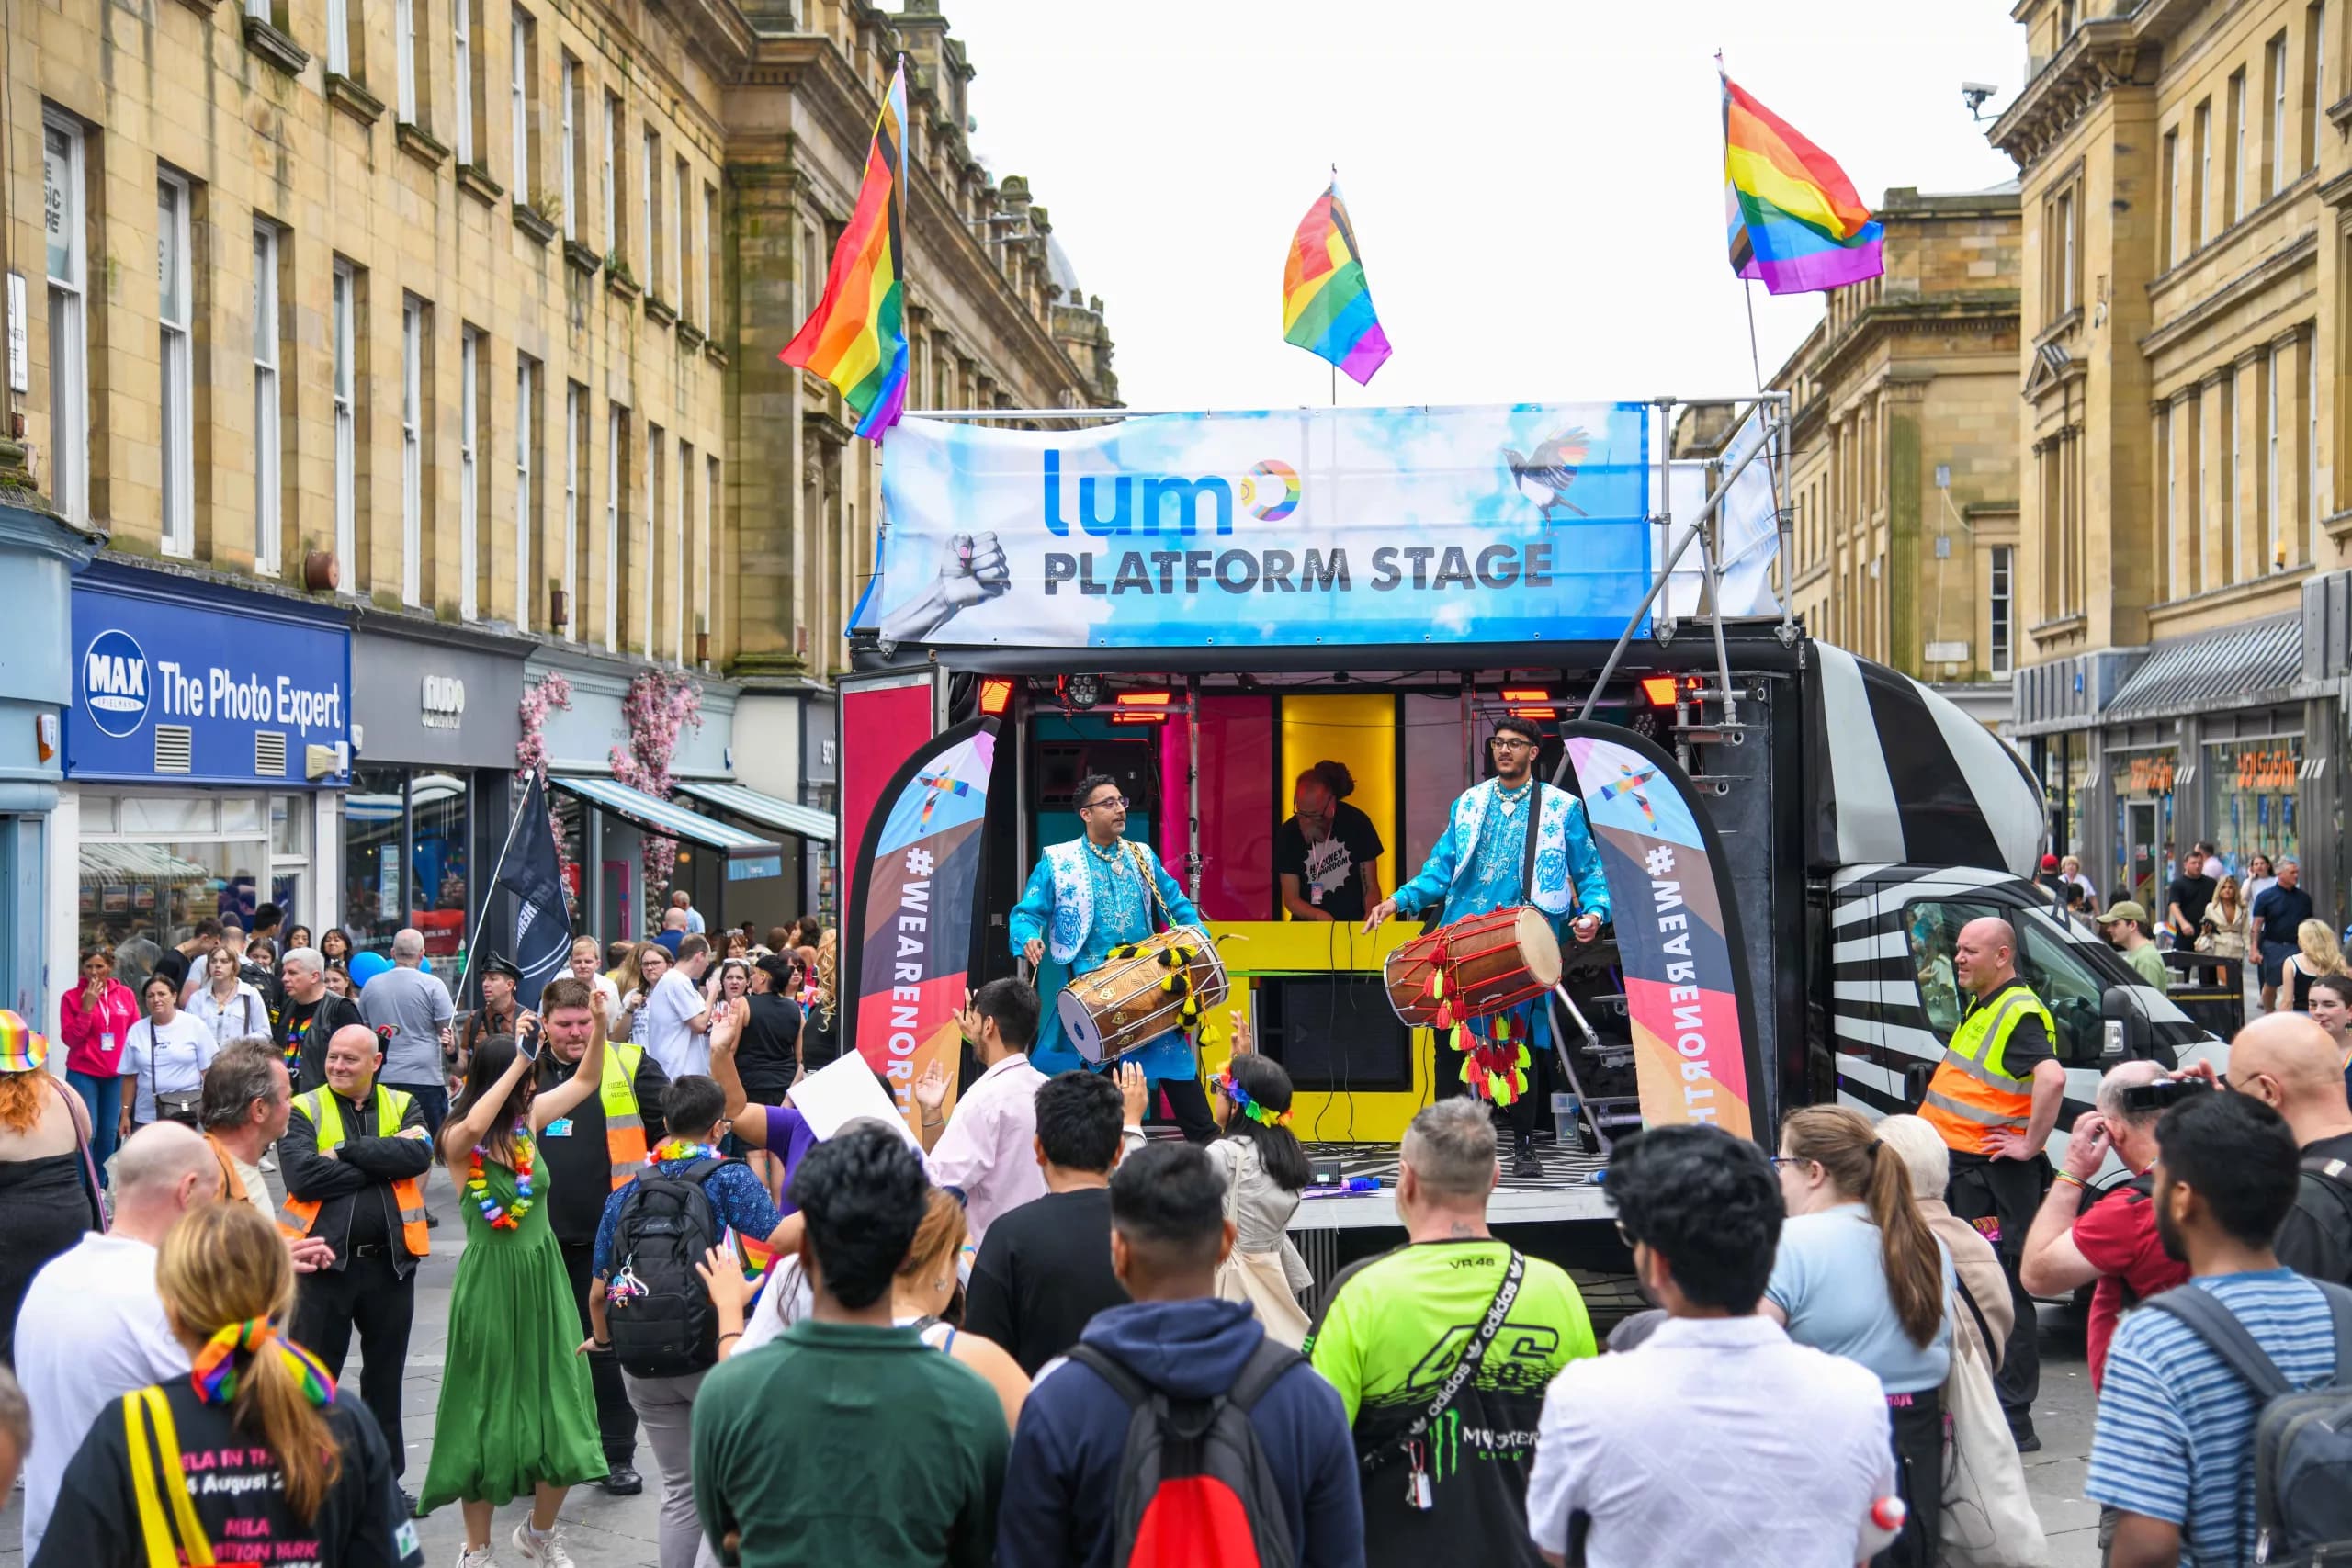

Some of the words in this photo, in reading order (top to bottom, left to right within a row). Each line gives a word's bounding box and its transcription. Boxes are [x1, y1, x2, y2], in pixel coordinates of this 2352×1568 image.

[1044, 448, 1301, 537] lumo
[1044, 548, 1352, 595] PLATFORM
[1370, 543, 1553, 592] STAGE
[89, 653, 146, 697] MAX
[158, 661, 204, 717] The
[209, 667, 273, 723] Photo
[277, 675, 342, 738] Expert
[1481, 1281, 1518, 1339] adidas
[1428, 1363, 1471, 1416] adidas
[180, 1450, 217, 1471] ELA
[220, 1450, 243, 1467] IN
[202, 1473, 267, 1496] August
